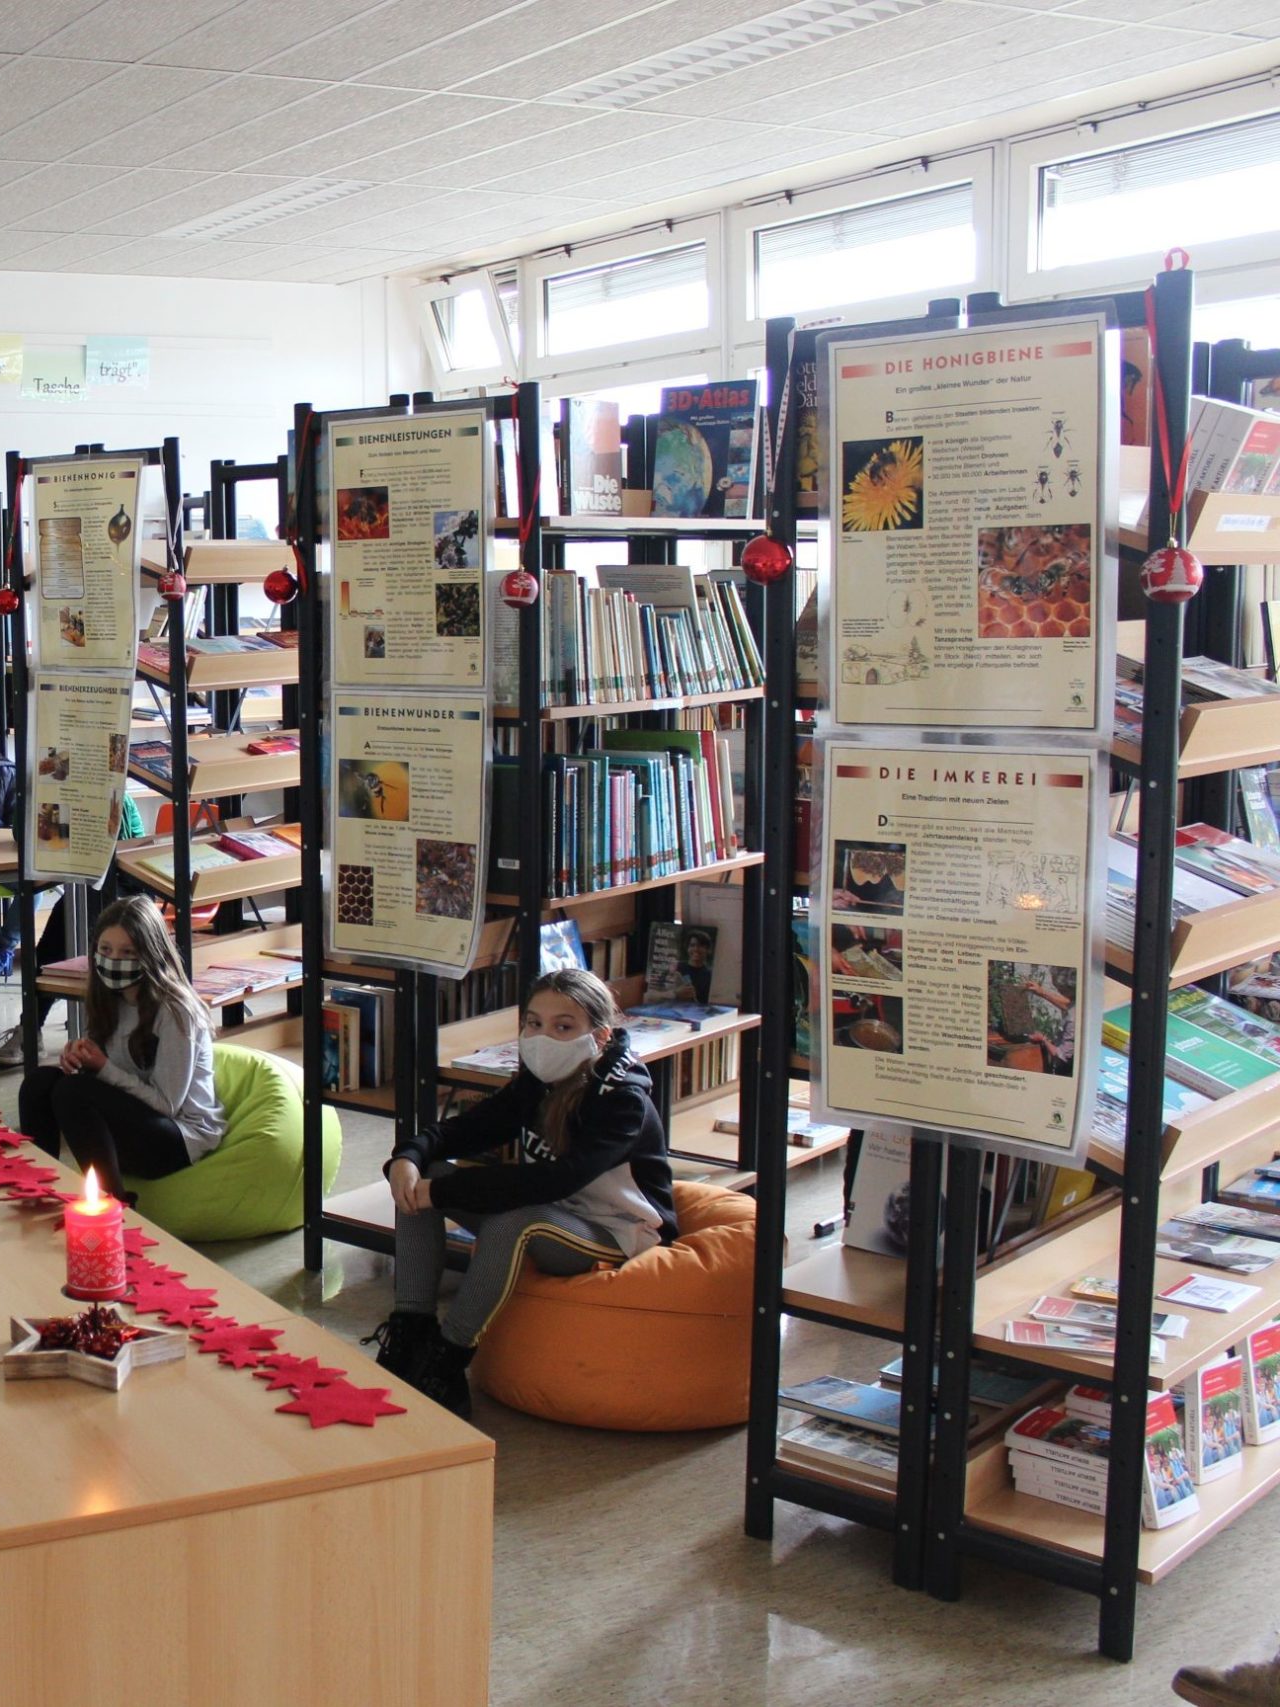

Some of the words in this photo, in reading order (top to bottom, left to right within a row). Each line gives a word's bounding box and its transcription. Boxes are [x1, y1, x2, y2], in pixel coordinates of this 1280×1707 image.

[886, 360, 913, 375] DIE
[923, 346, 1043, 371] HONIGBIENE
[33, 377, 79, 394] Tasche
[359, 429, 451, 444] BIENENLEISTUNGEN
[945, 437, 968, 445] Königin
[54, 472, 115, 482] BIENENHONIG
[594, 474, 618, 493] Die
[59, 685, 117, 694] BIENENERZEUGNISSE
[364, 707, 454, 719] BIENENWUNDER
[880, 767, 915, 780] DIE
[933, 769, 1036, 785] IMKEREI
[918, 794, 946, 802] Tradition
